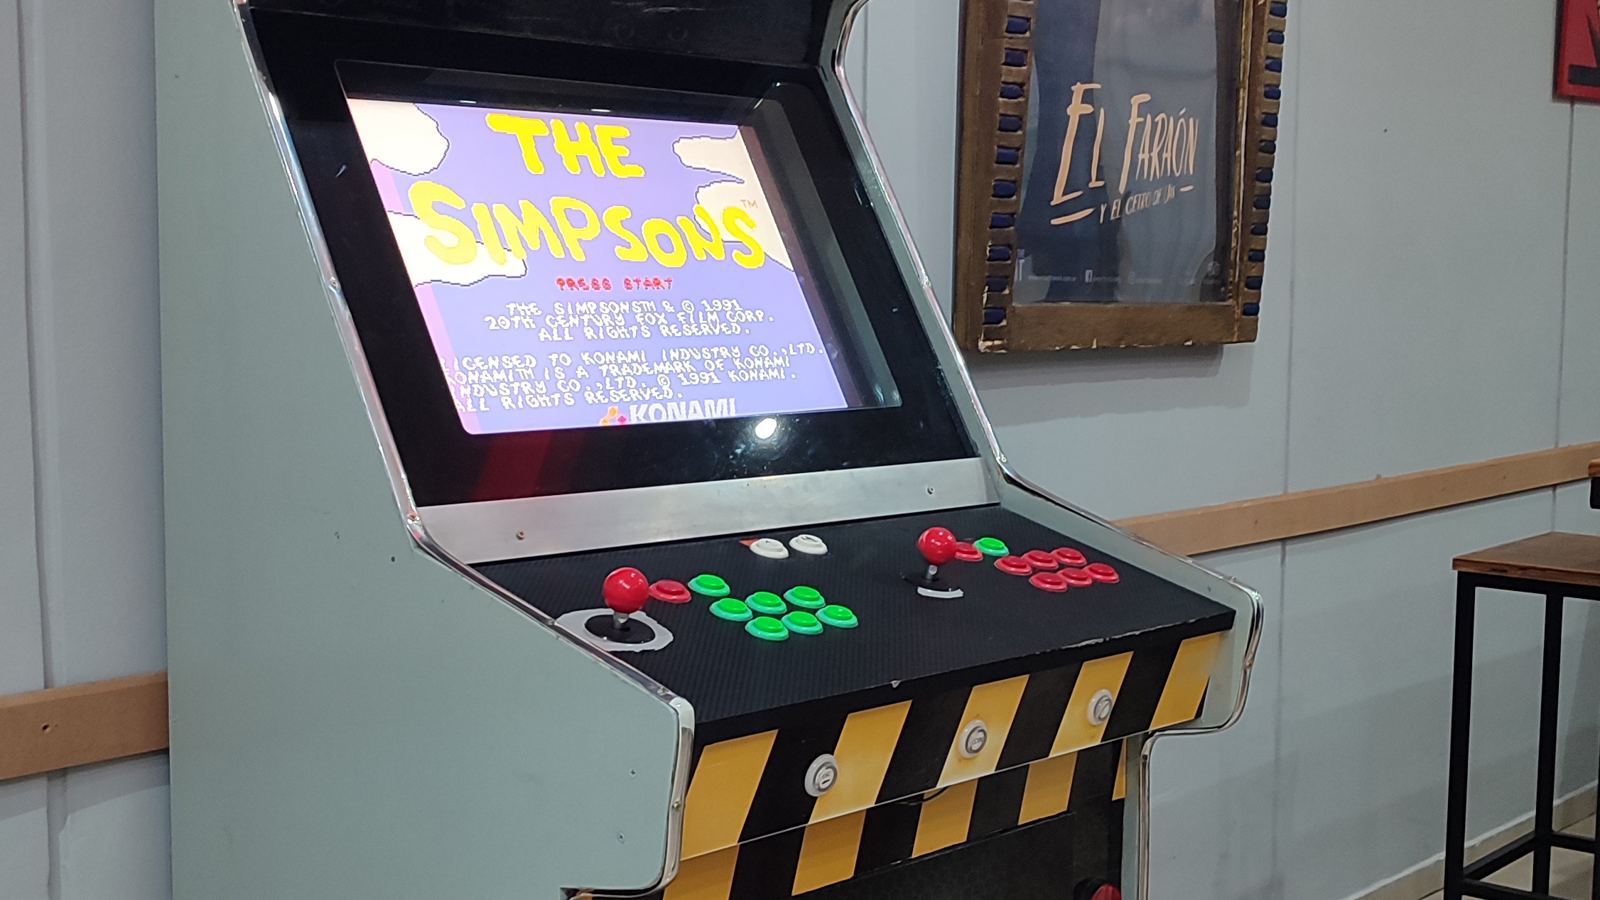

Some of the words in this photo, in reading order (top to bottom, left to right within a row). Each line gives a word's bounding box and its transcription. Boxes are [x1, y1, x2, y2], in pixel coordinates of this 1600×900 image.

[486, 112, 645, 178] THE
[1050, 82, 1105, 206] EL
[1118, 94, 1198, 194] FARAÓN
[1100, 203, 1107, 224] Y
[1111, 198, 1121, 220] EL
[408, 180, 766, 269] SIMPSONS
[555, 277, 612, 291] PRESS
[623, 276, 673, 290] START
[484, 316, 536, 330] 20TH
[545, 313, 625, 328] CENTURY
[636, 312, 668, 326] FOX
[677, 311, 720, 324] FILM
[726, 309, 775, 323] CORP.
[506, 302, 543, 316] THE
[662, 300, 675, 313] &
[701, 299, 743, 312] 1991
[538, 327, 574, 341] ALL
[583, 325, 651, 340] RIGHTS
[660, 322, 750, 338] RESERVED.
[544, 367, 566, 380] IS
[575, 365, 589, 378] A
[599, 360, 696, 377] TRADEMARK
[704, 357, 724, 371] OF
[733, 354, 790, 370] KONAMI
[548, 353, 573, 367] TO
[580, 350, 647, 365] KONAMI
[662, 346, 741, 361] INDUSTRY
[678, 371, 721, 386] 1991
[454, 397, 489, 412] ALL
[502, 392, 575, 410] RIGHTS
[584, 387, 683, 404] RESERVED.
[629, 398, 736, 423] KONAMI
